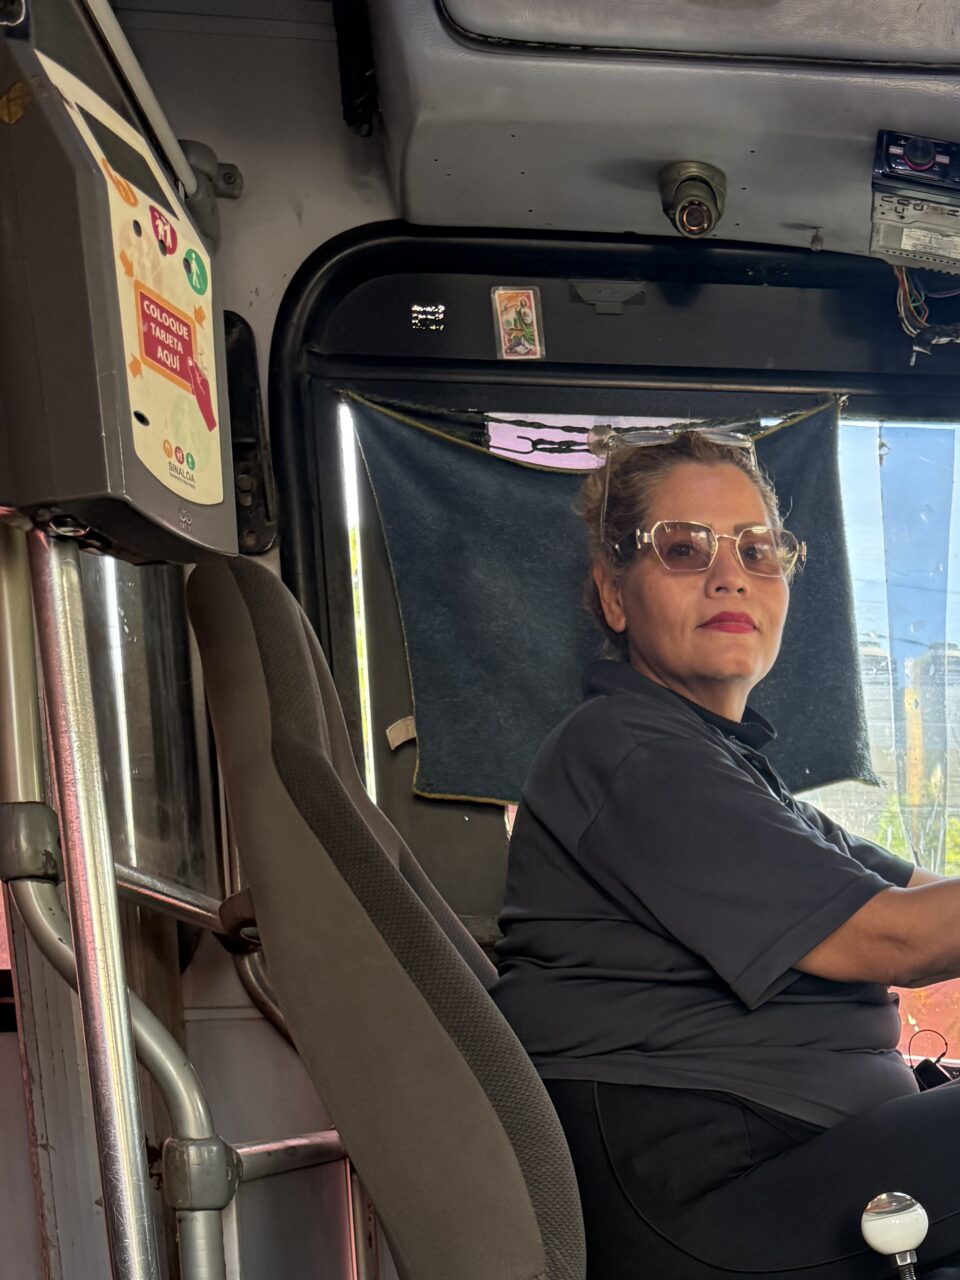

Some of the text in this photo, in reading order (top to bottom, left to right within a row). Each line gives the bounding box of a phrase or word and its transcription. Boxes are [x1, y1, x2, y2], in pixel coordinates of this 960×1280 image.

[143, 300, 189, 340] COLOQUE
[150, 322, 183, 354] TARJETA
[157, 345, 180, 372] AQUÍ
[168, 461, 196, 483] SINALOA
